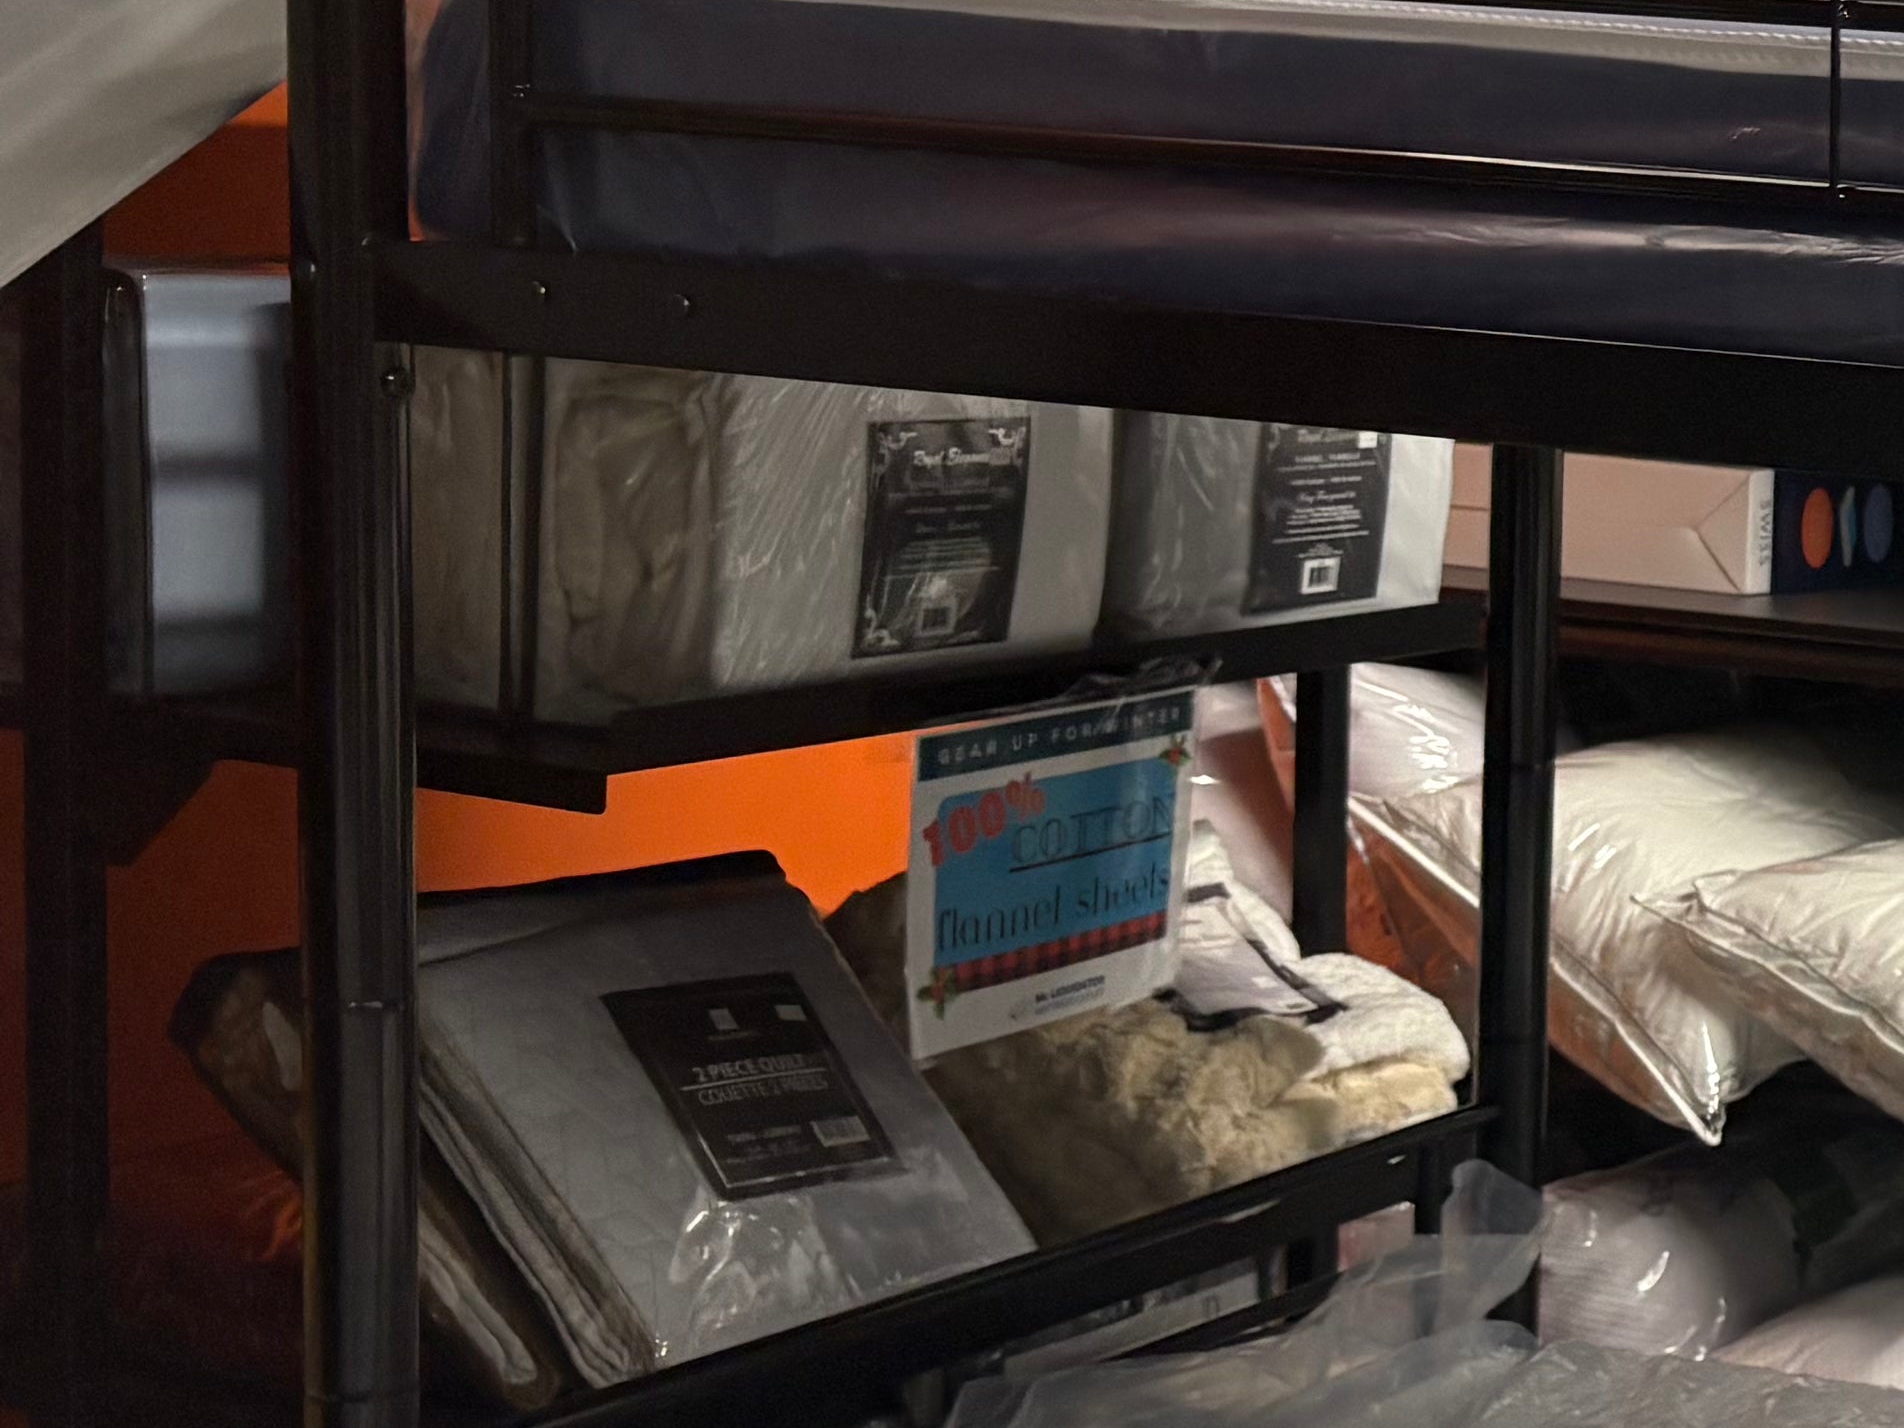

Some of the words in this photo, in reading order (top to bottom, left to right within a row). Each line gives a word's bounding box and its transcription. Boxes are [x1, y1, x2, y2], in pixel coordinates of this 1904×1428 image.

[1011, 732, 1039, 752] UP
[922, 772, 1047, 869] 100%
[1012, 793, 1178, 865] COTTON
[937, 884, 1062, 953] flannel
[1075, 861, 1172, 922] sheets
